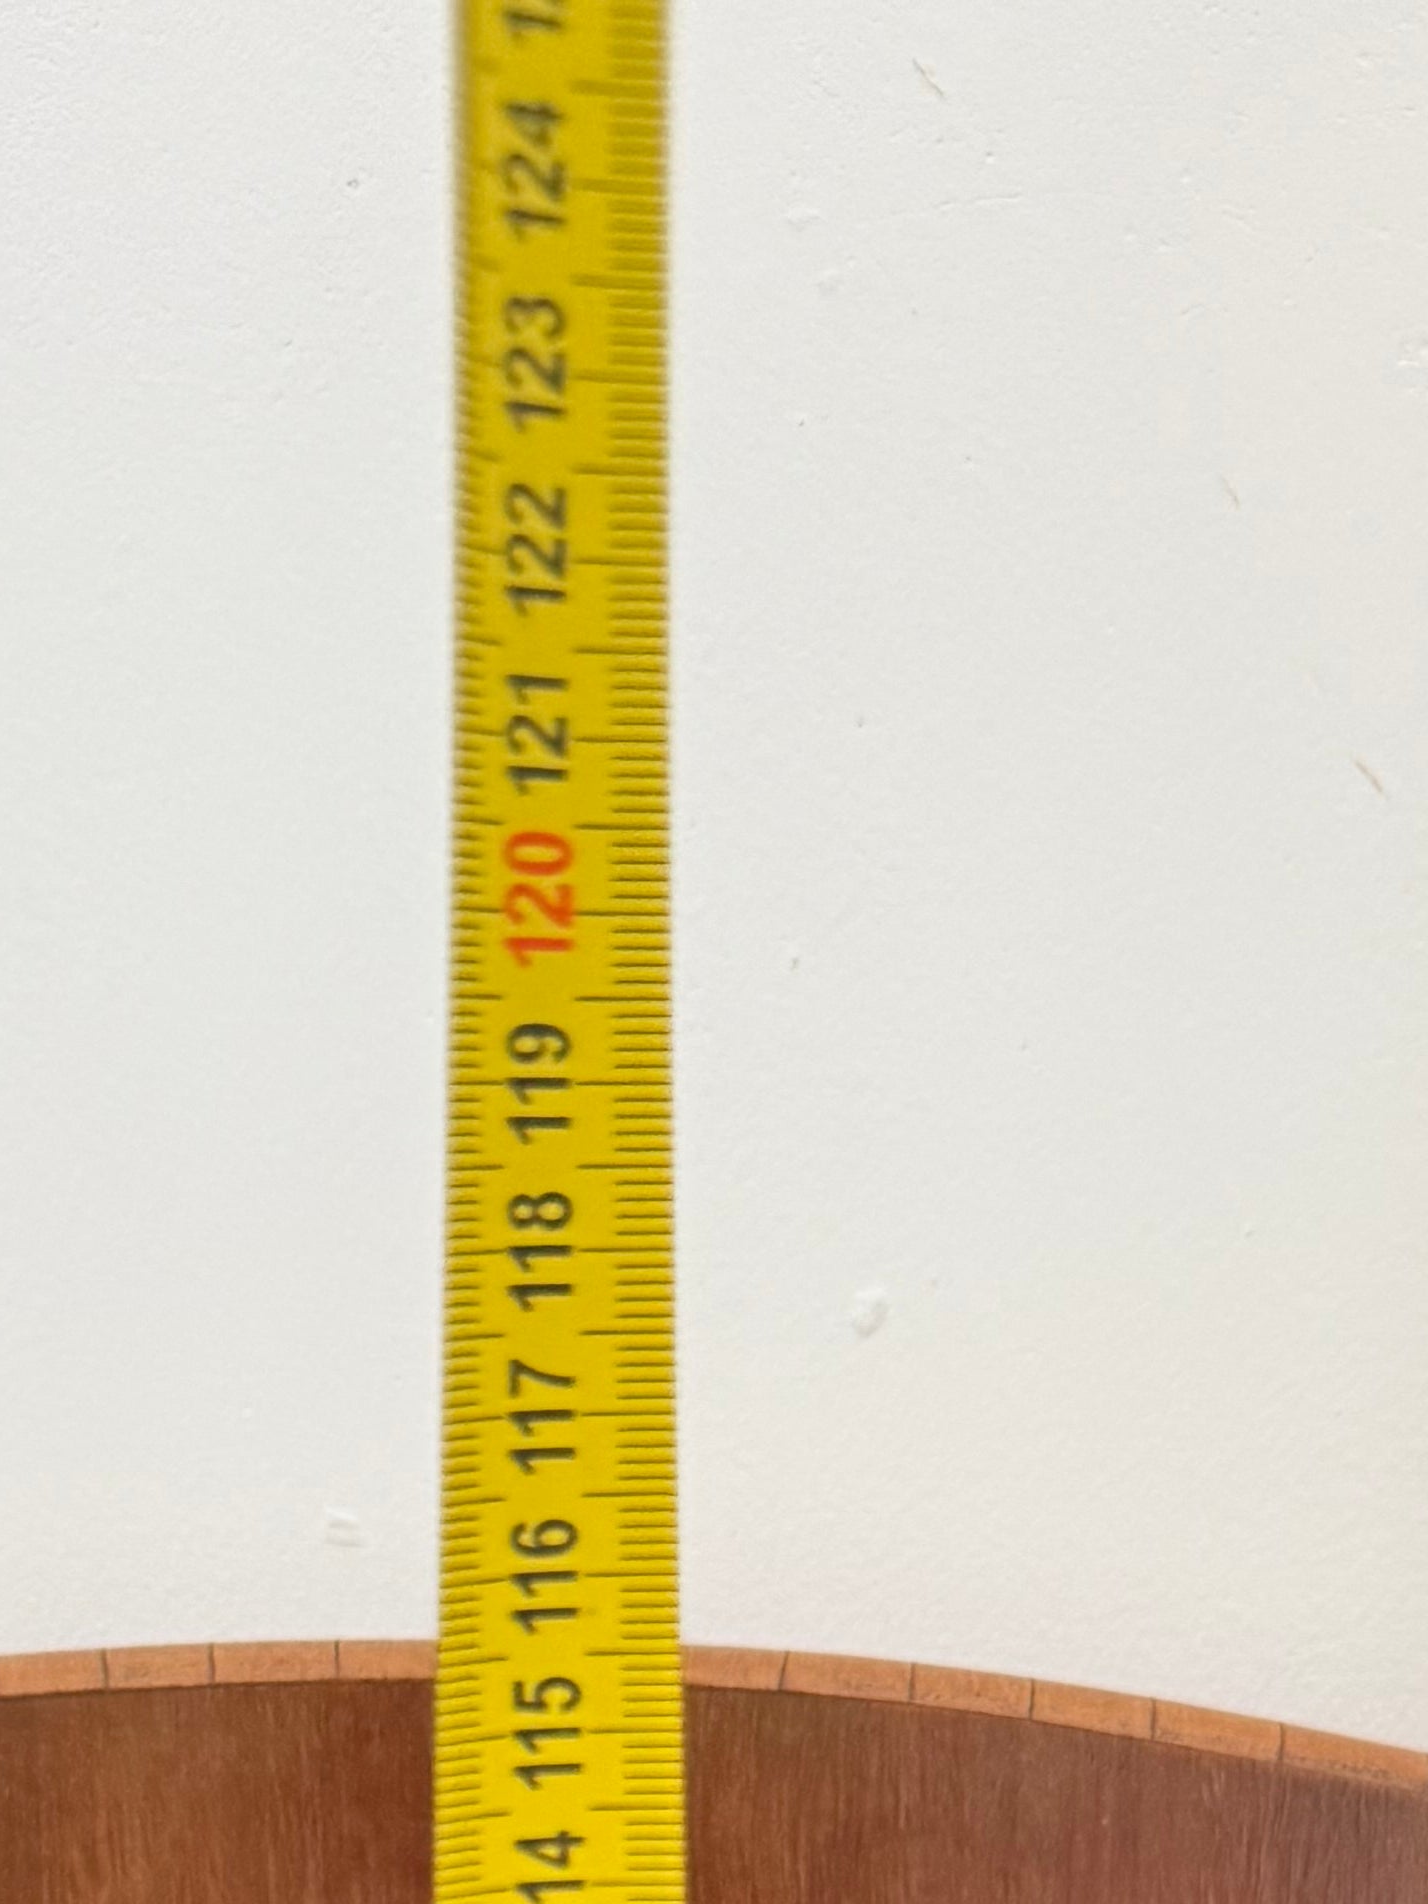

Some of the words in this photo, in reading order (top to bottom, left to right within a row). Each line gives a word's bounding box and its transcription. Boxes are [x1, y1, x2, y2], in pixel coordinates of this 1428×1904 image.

[501, 100, 568, 238] 124
[501, 295, 569, 430] 123
[502, 482, 569, 615] 122
[503, 673, 570, 794] 121
[503, 830, 576, 966] 120
[504, 1022, 573, 1144] 119
[505, 1191, 575, 1311] 118
[506, 1358, 578, 1475] 117
[507, 1518, 579, 1633] 116
[511, 1676, 583, 1790] 115
